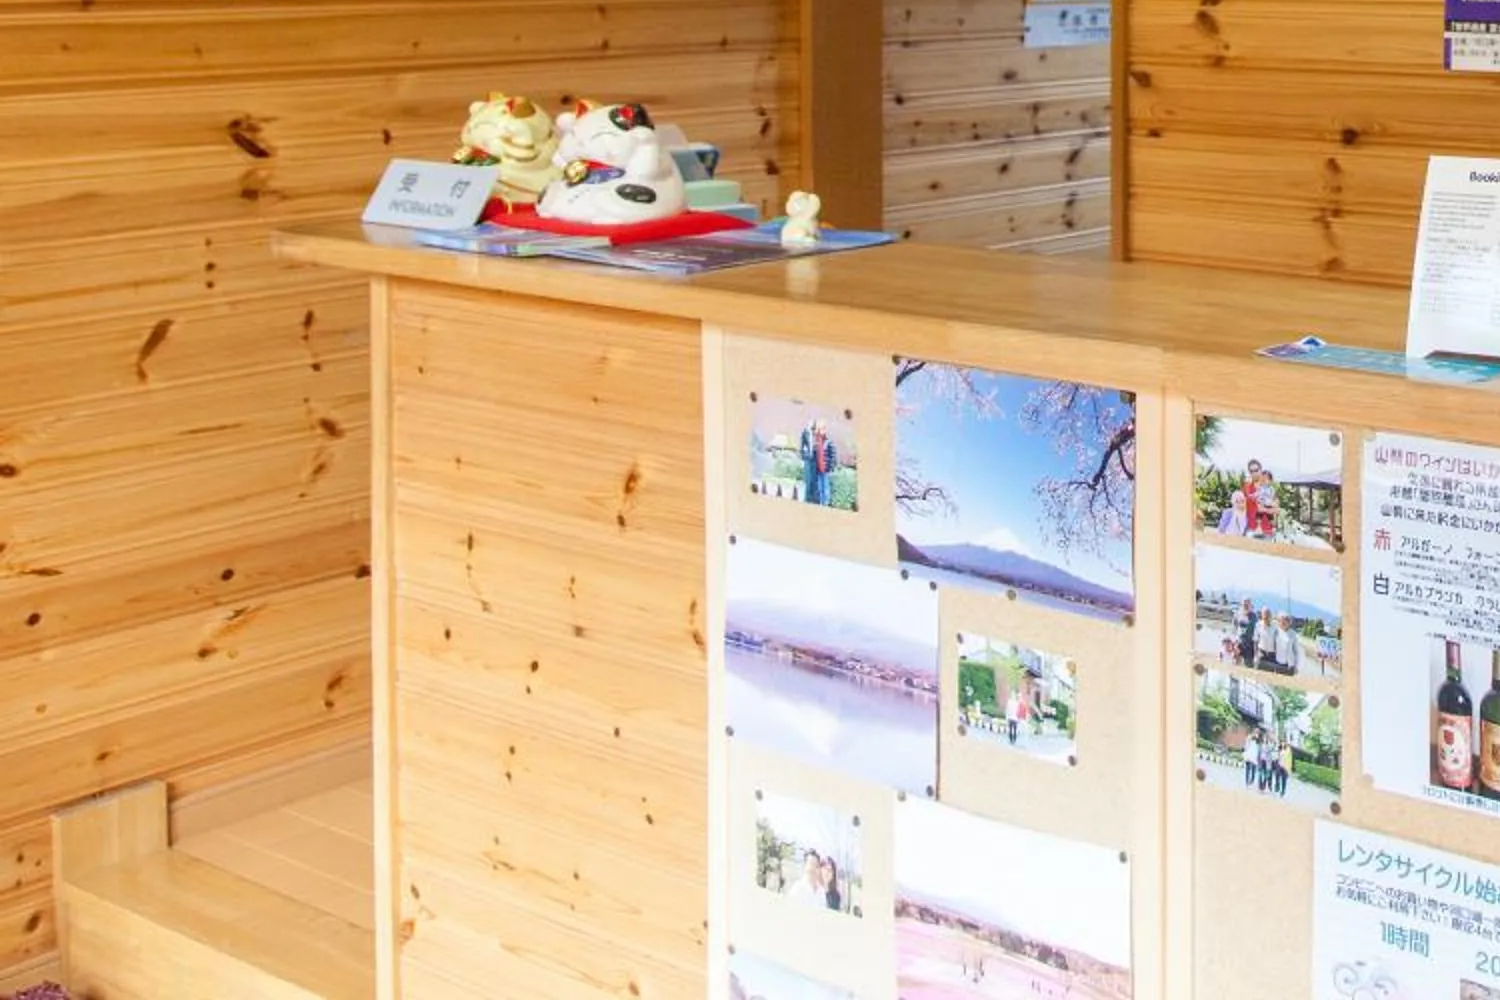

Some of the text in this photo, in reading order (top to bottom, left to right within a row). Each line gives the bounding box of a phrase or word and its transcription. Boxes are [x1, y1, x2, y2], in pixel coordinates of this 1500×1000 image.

[1373, 527, 1392, 551] 赤
[1373, 571, 1390, 596] 白
[1379, 920, 1431, 959] 1時間
